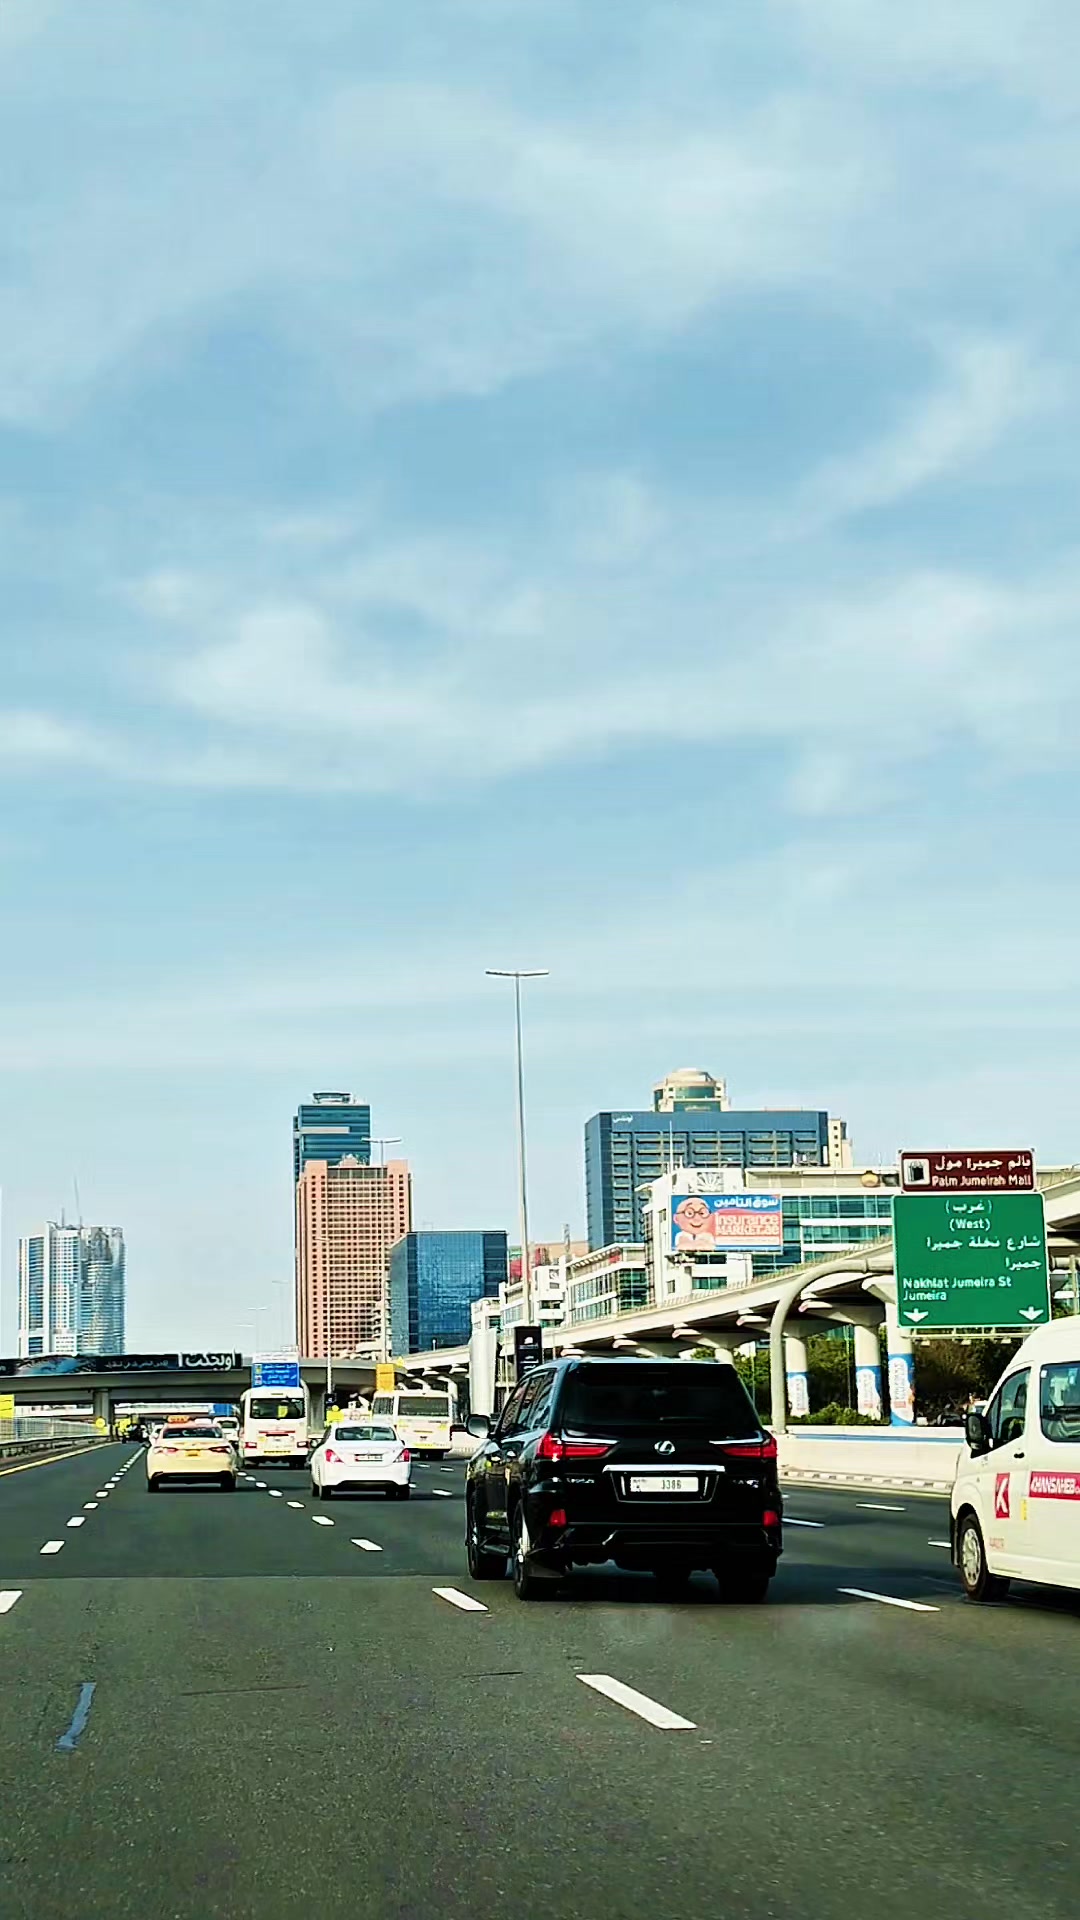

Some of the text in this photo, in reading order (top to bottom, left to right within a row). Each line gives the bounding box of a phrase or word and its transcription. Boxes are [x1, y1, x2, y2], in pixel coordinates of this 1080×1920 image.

[935, 1155, 962, 1171] مول
[967, 1157, 1003, 1171] جميرا
[932, 1174, 1032, 1186] Palm Jumeirah Mall
[752, 1196, 779, 1208] سوق
[949, 1218, 991, 1232] (West)
[926, 1235, 1041, 1251] شارع نخلة جميرا
[1005, 1257, 1042, 1271] جميرا
[902, 1275, 1012, 1289] Nakhlat Jumeira St
[902, 1289, 947, 1301] Jumeira
